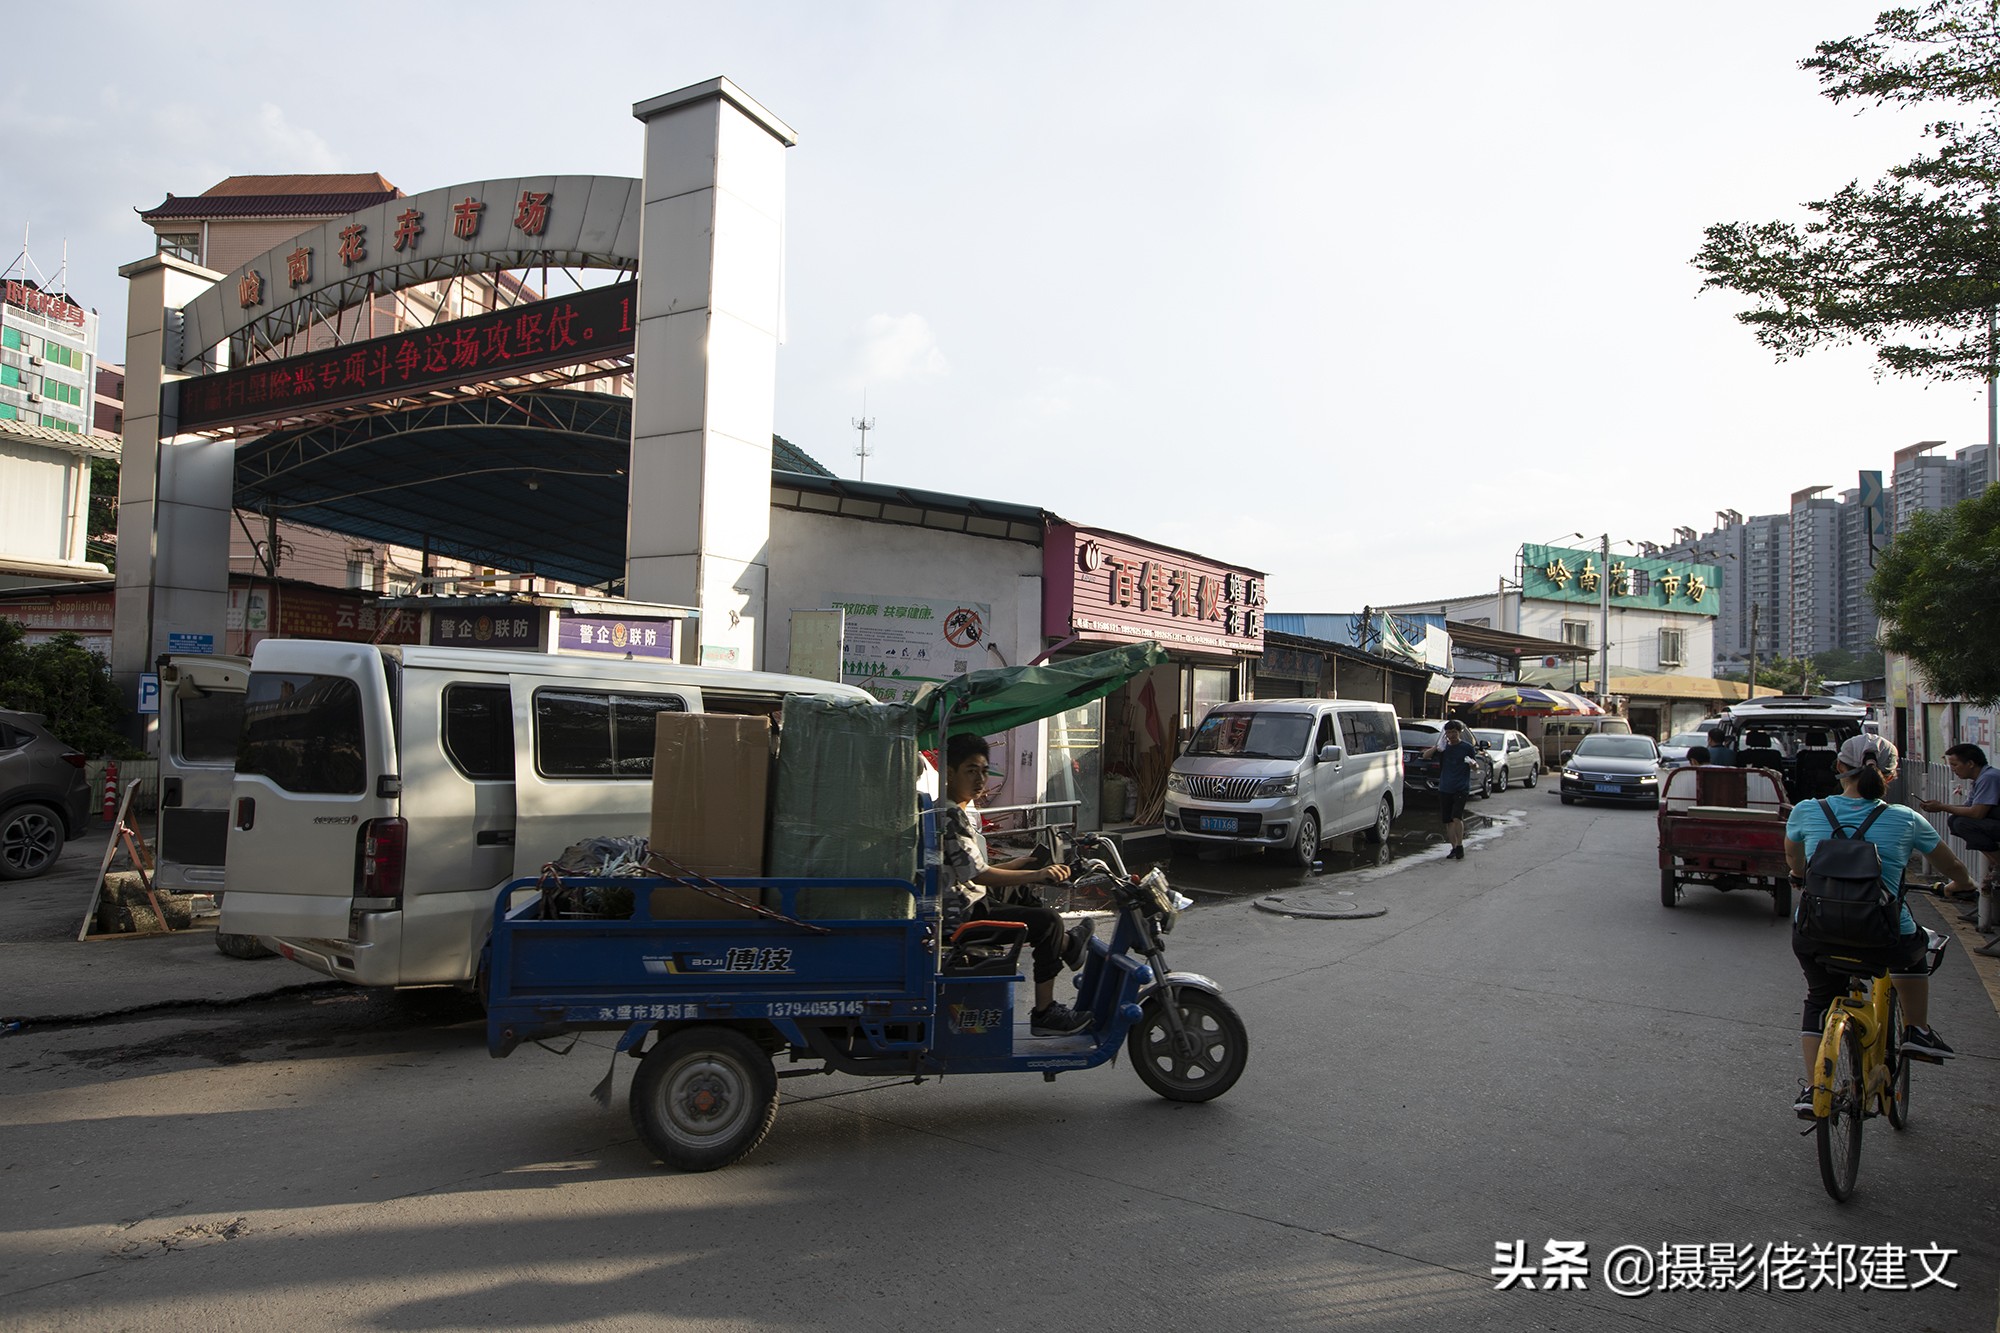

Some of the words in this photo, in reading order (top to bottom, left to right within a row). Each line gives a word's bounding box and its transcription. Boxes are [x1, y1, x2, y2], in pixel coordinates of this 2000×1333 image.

[238, 190, 552, 310] 岭南花卉市场
[1108, 555, 1222, 621] 百佳礼仪
[1229, 572, 1262, 606] 婚庆
[1228, 604, 1261, 638] 花店
[142, 682, 158, 705] P
[691, 958, 724, 966] BOJI
[726, 947, 793, 972] 博技
[599, 1003, 699, 1020] 永盛市场对面
[766, 1000, 865, 1017] 13794055145
[957, 1008, 1002, 1029] 博技
